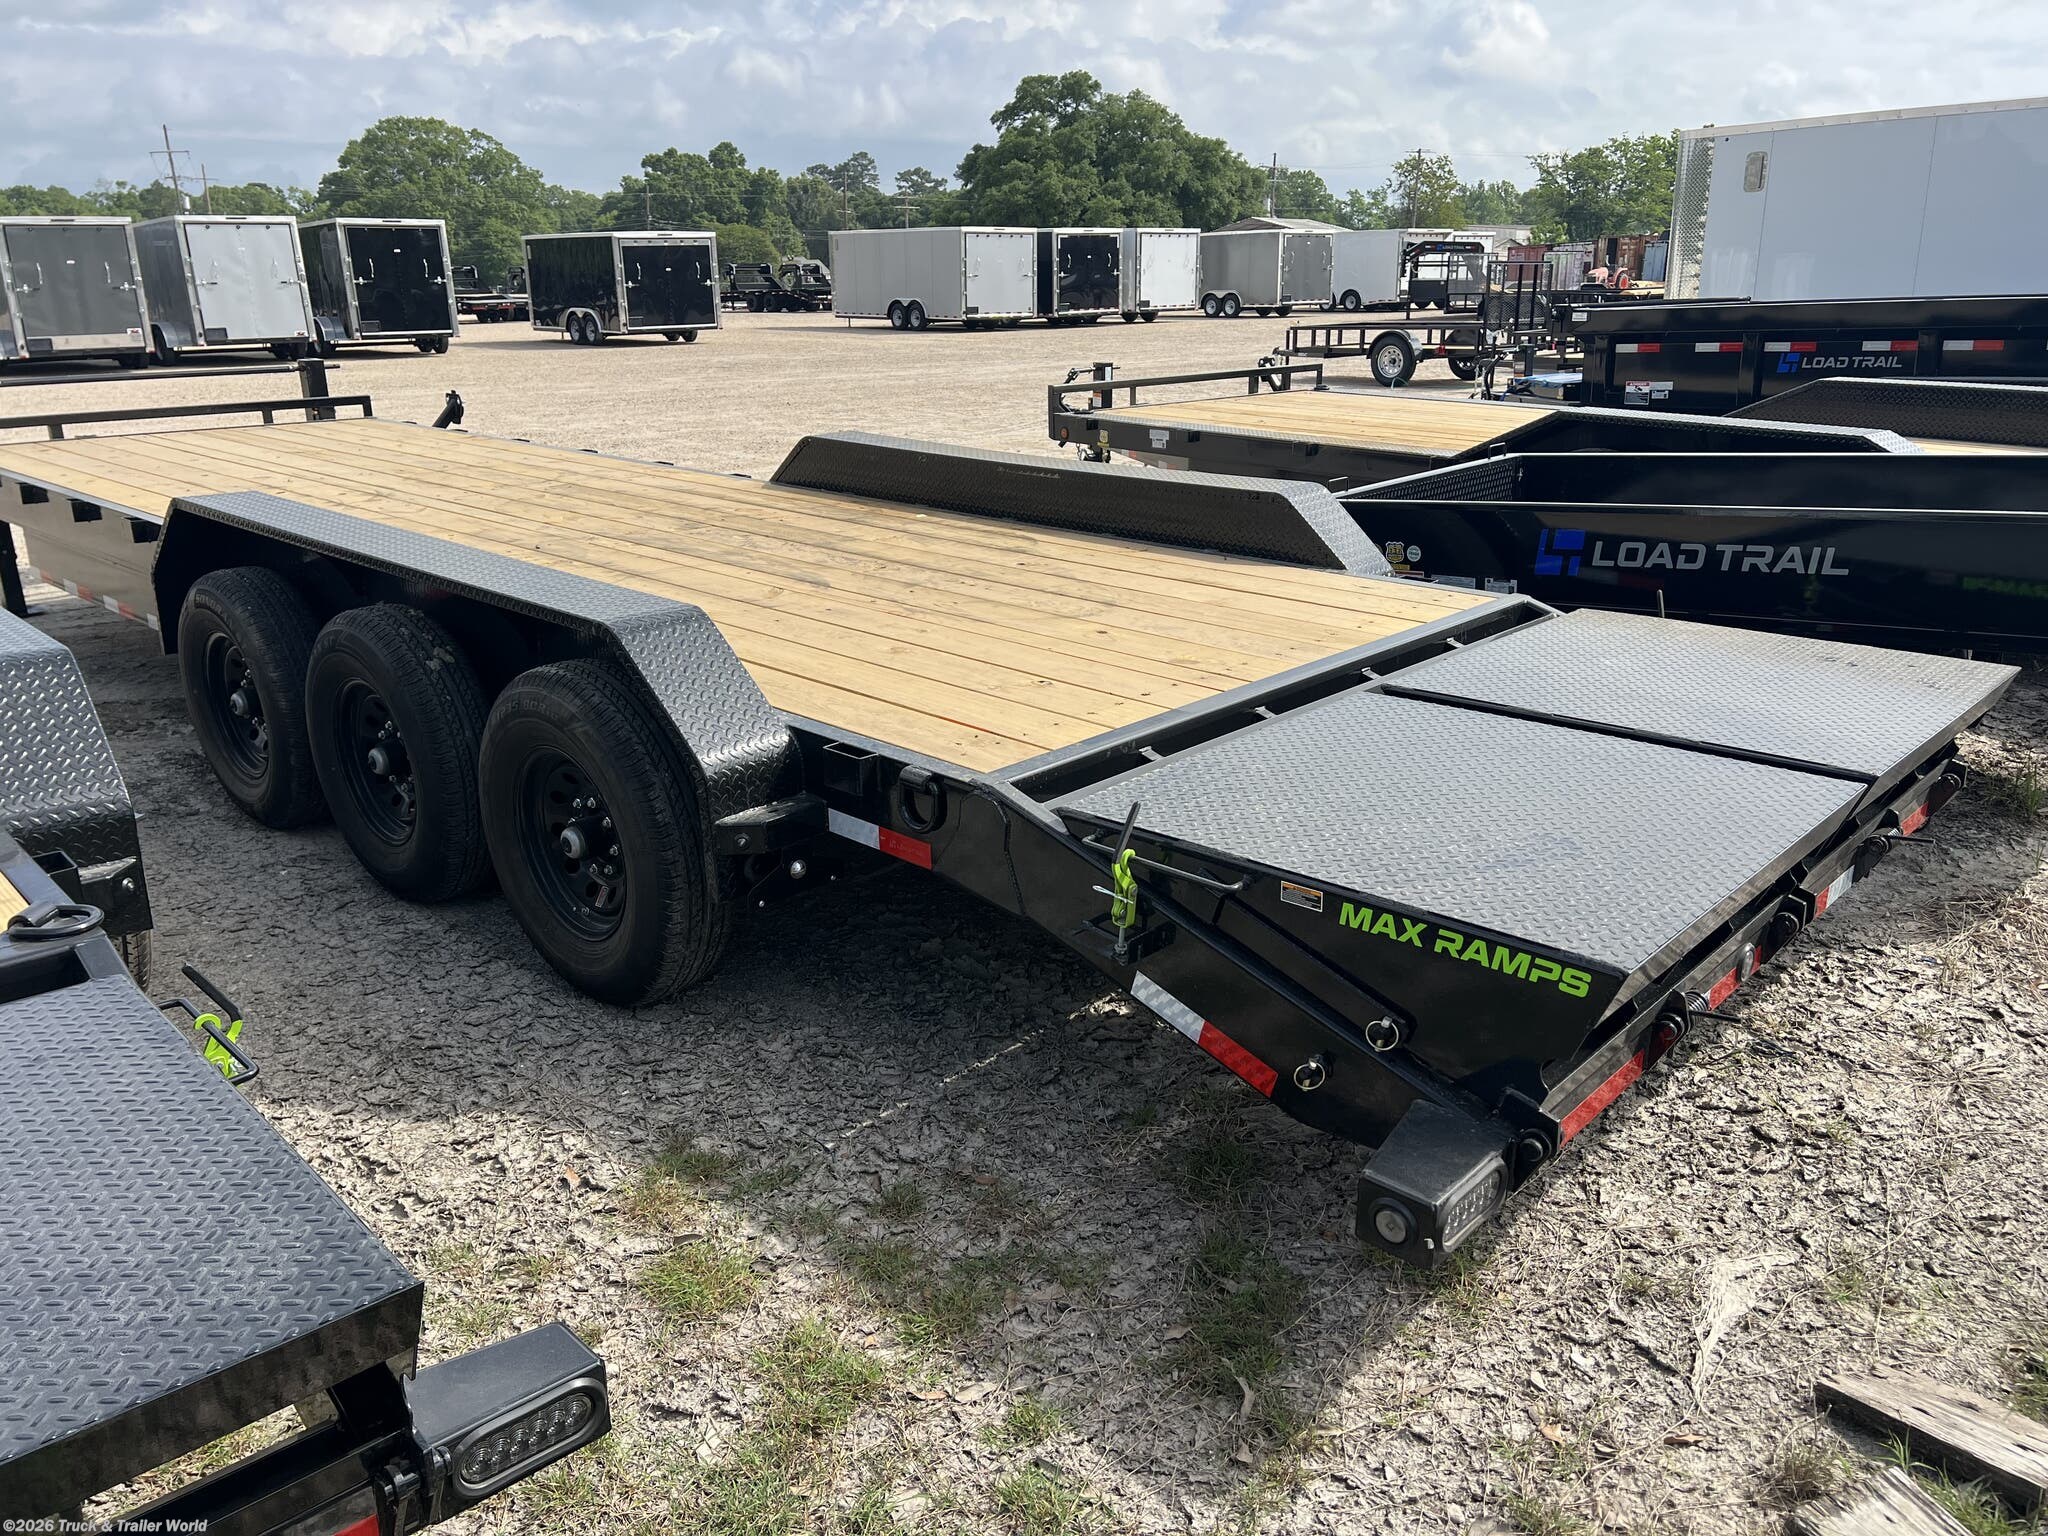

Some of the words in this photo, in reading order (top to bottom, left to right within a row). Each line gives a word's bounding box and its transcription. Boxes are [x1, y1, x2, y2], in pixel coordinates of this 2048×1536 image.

[1801, 357, 1849, 369] LOAD
[1852, 356, 1903, 368] TRAIL
[1591, 541, 1707, 570] LOAD
[1715, 544, 1849, 576] TRAIL
[1338, 902, 1428, 948] MAX
[1433, 929, 1592, 998] RAMPS
